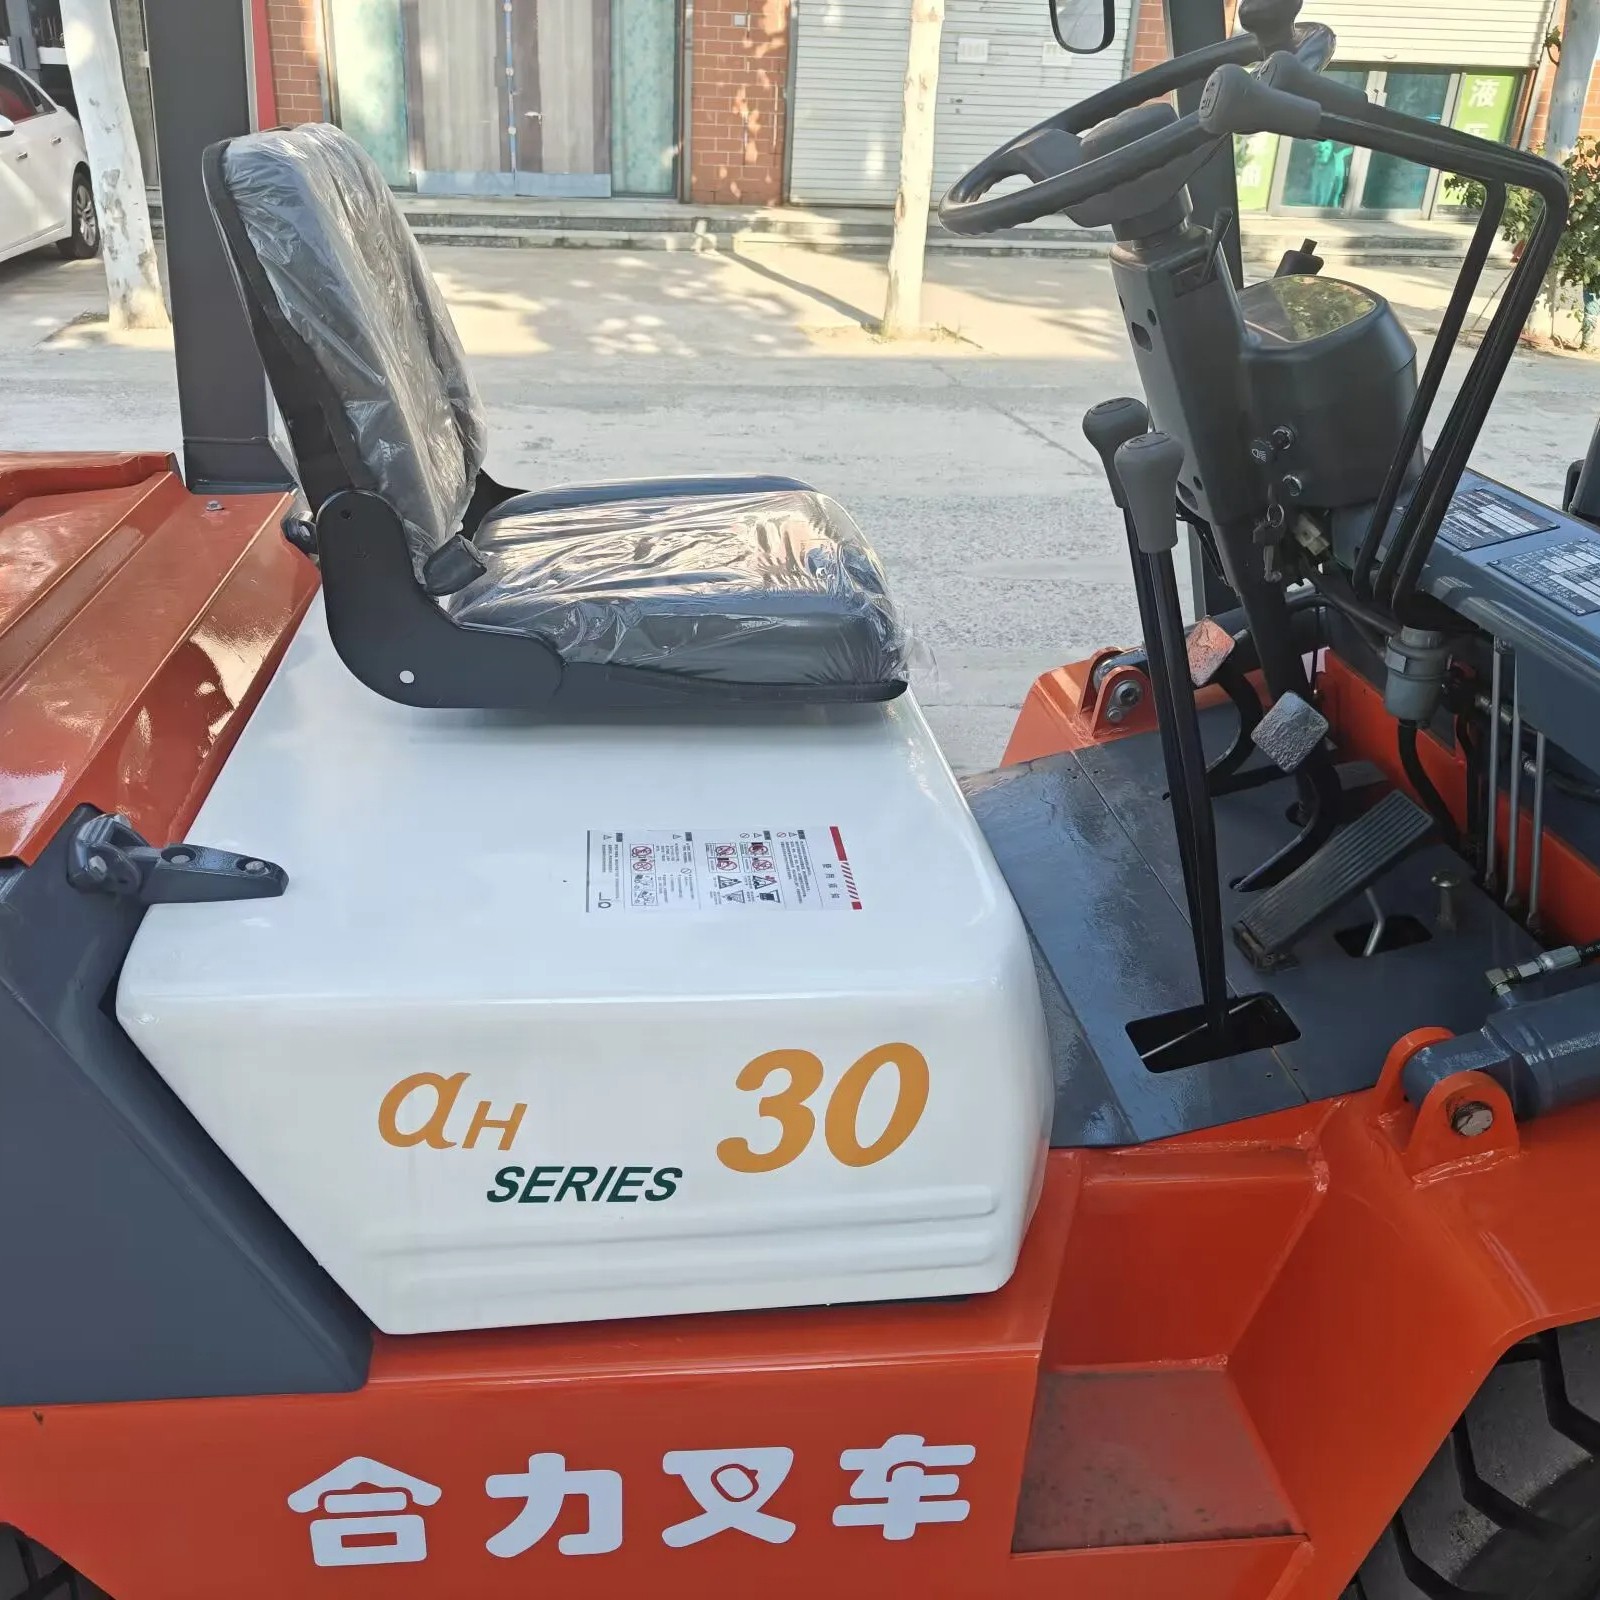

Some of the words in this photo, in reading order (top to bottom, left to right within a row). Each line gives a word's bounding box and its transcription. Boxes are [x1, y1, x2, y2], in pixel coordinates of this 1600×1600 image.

[716, 1042, 930, 1173] 30
[486, 1166, 683, 1203] SERIES
[287, 1433, 977, 1567] 合力叉车
